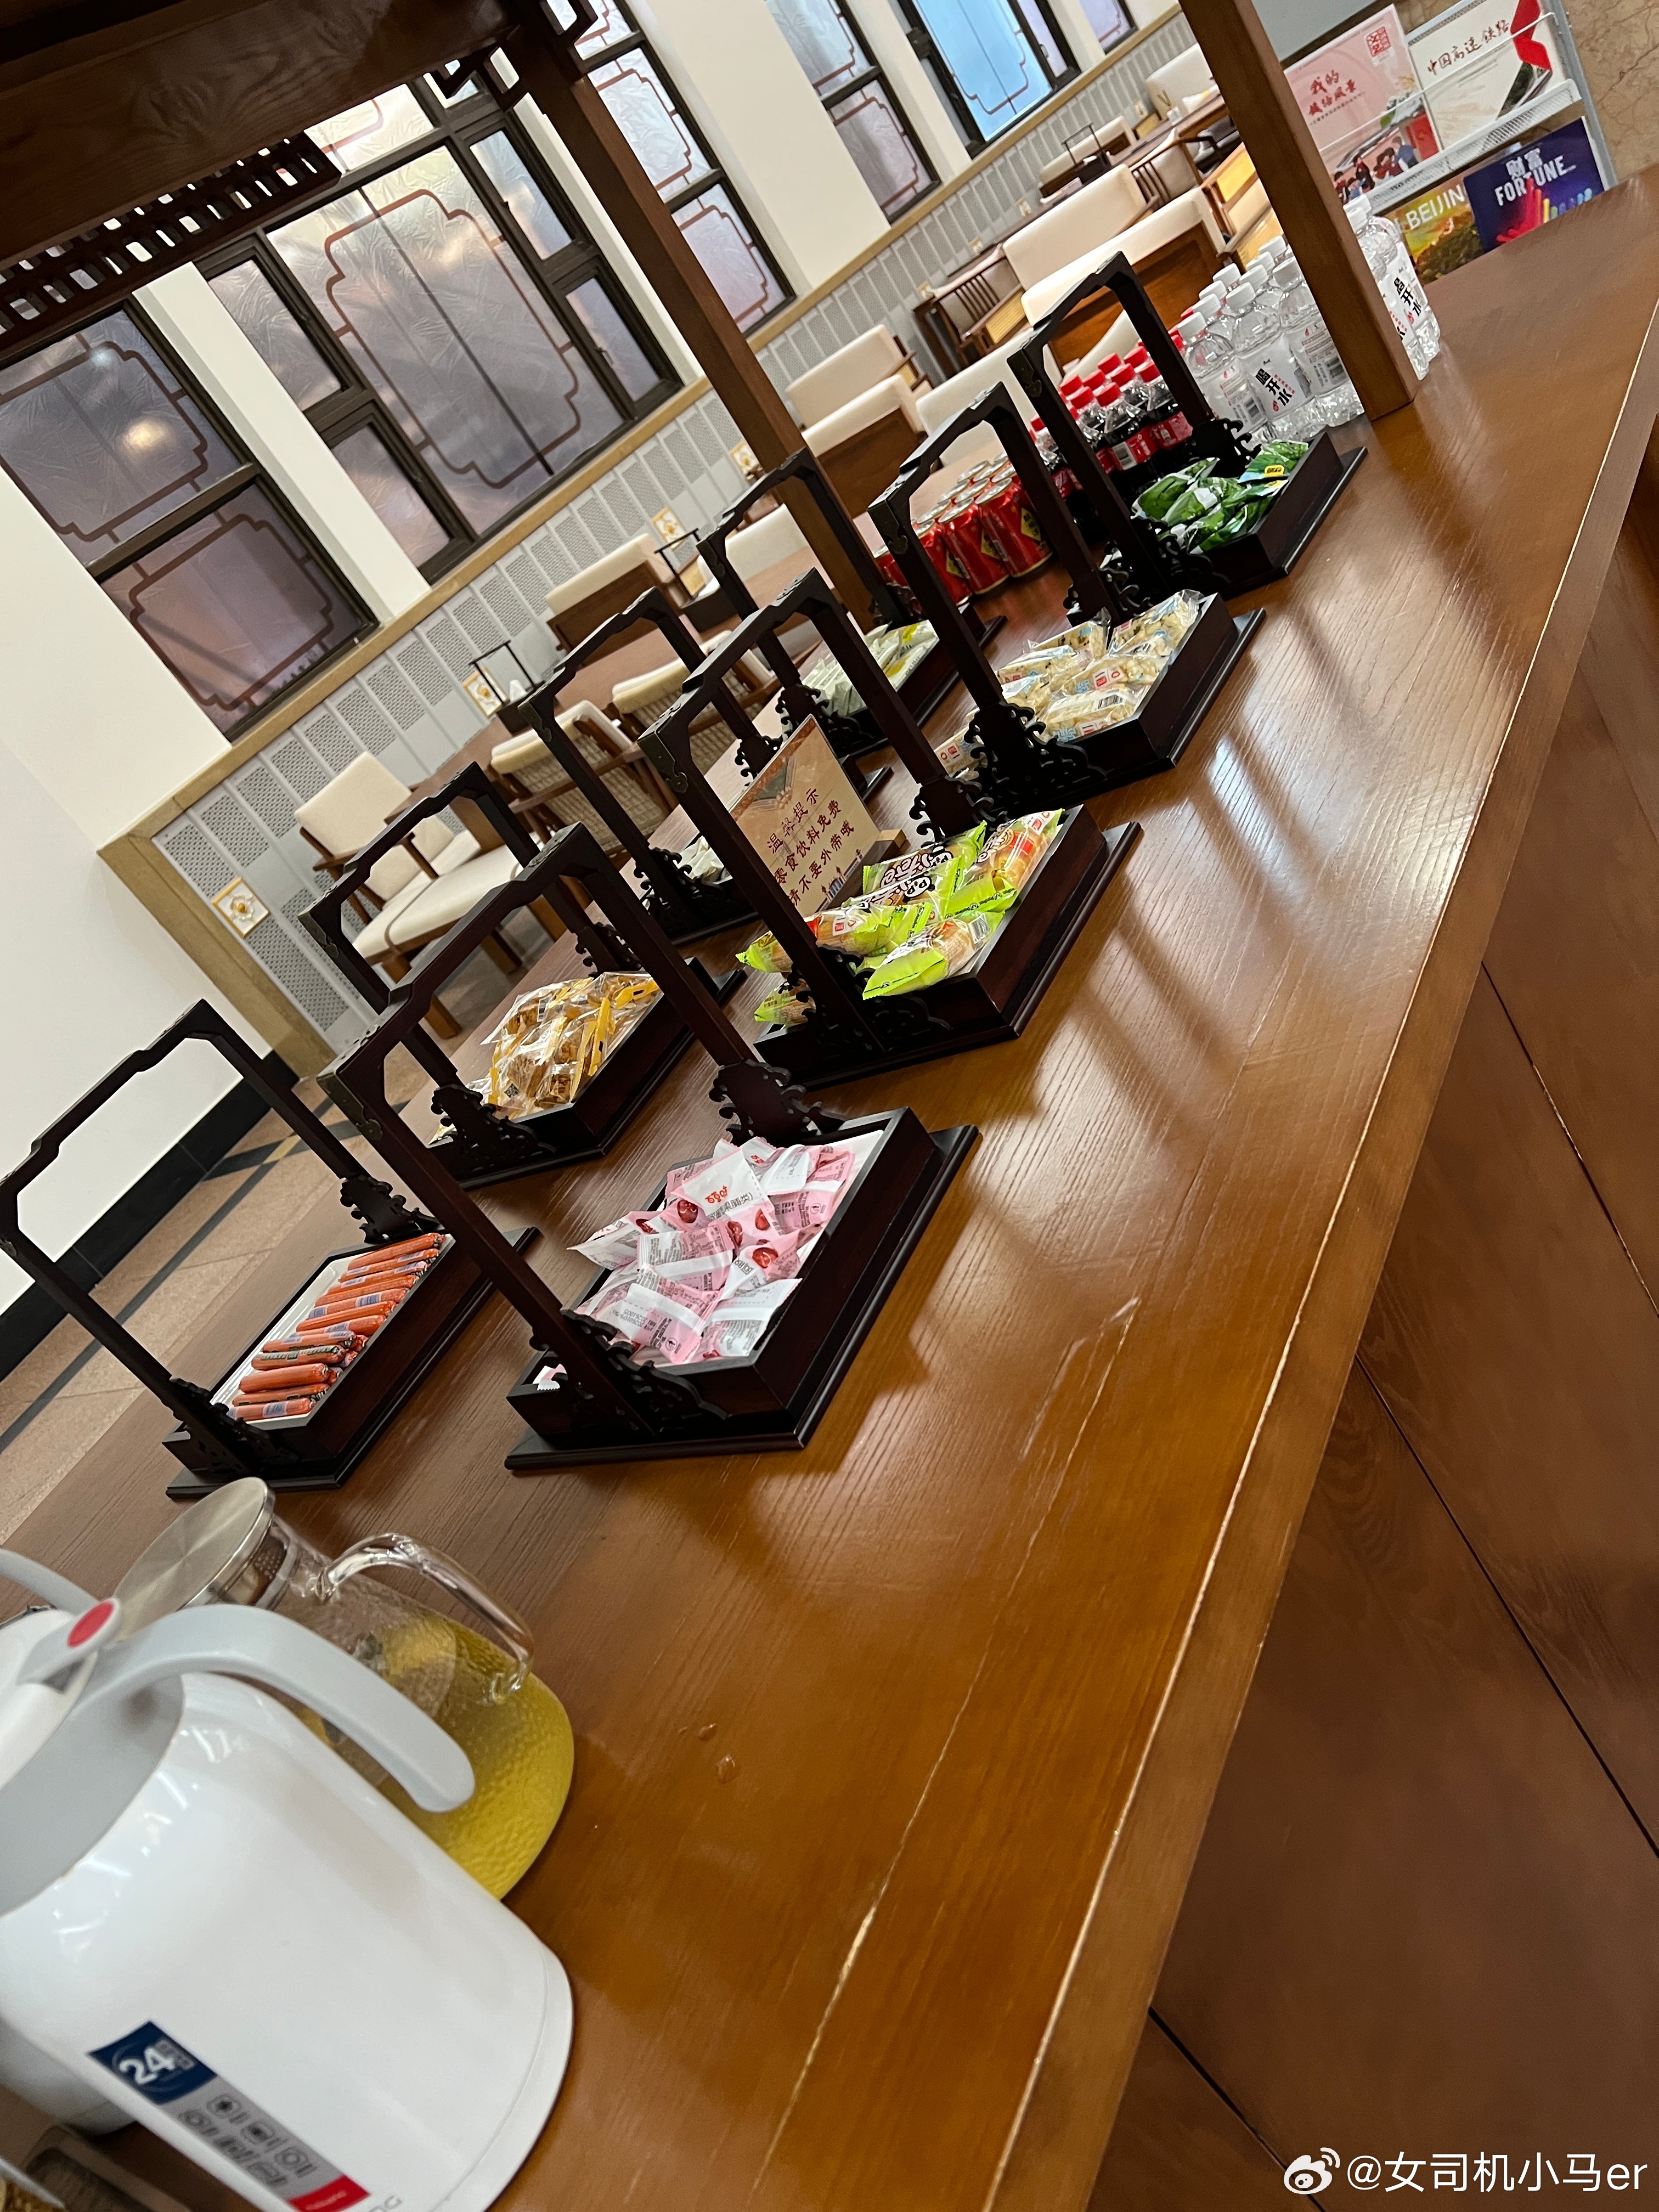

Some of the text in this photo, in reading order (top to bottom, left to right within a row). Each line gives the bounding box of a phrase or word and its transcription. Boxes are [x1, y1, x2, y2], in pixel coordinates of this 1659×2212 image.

[1427, 19, 1510, 75] 中国高速铁路
[1406, 184, 1466, 230] BEIJIN
[1255, 368, 1293, 407] 喝开水
[766, 787, 820, 854] 温馨提示
[774, 799, 842, 885] 零食饮料免费
[119, 2046, 176, 2085] 24
